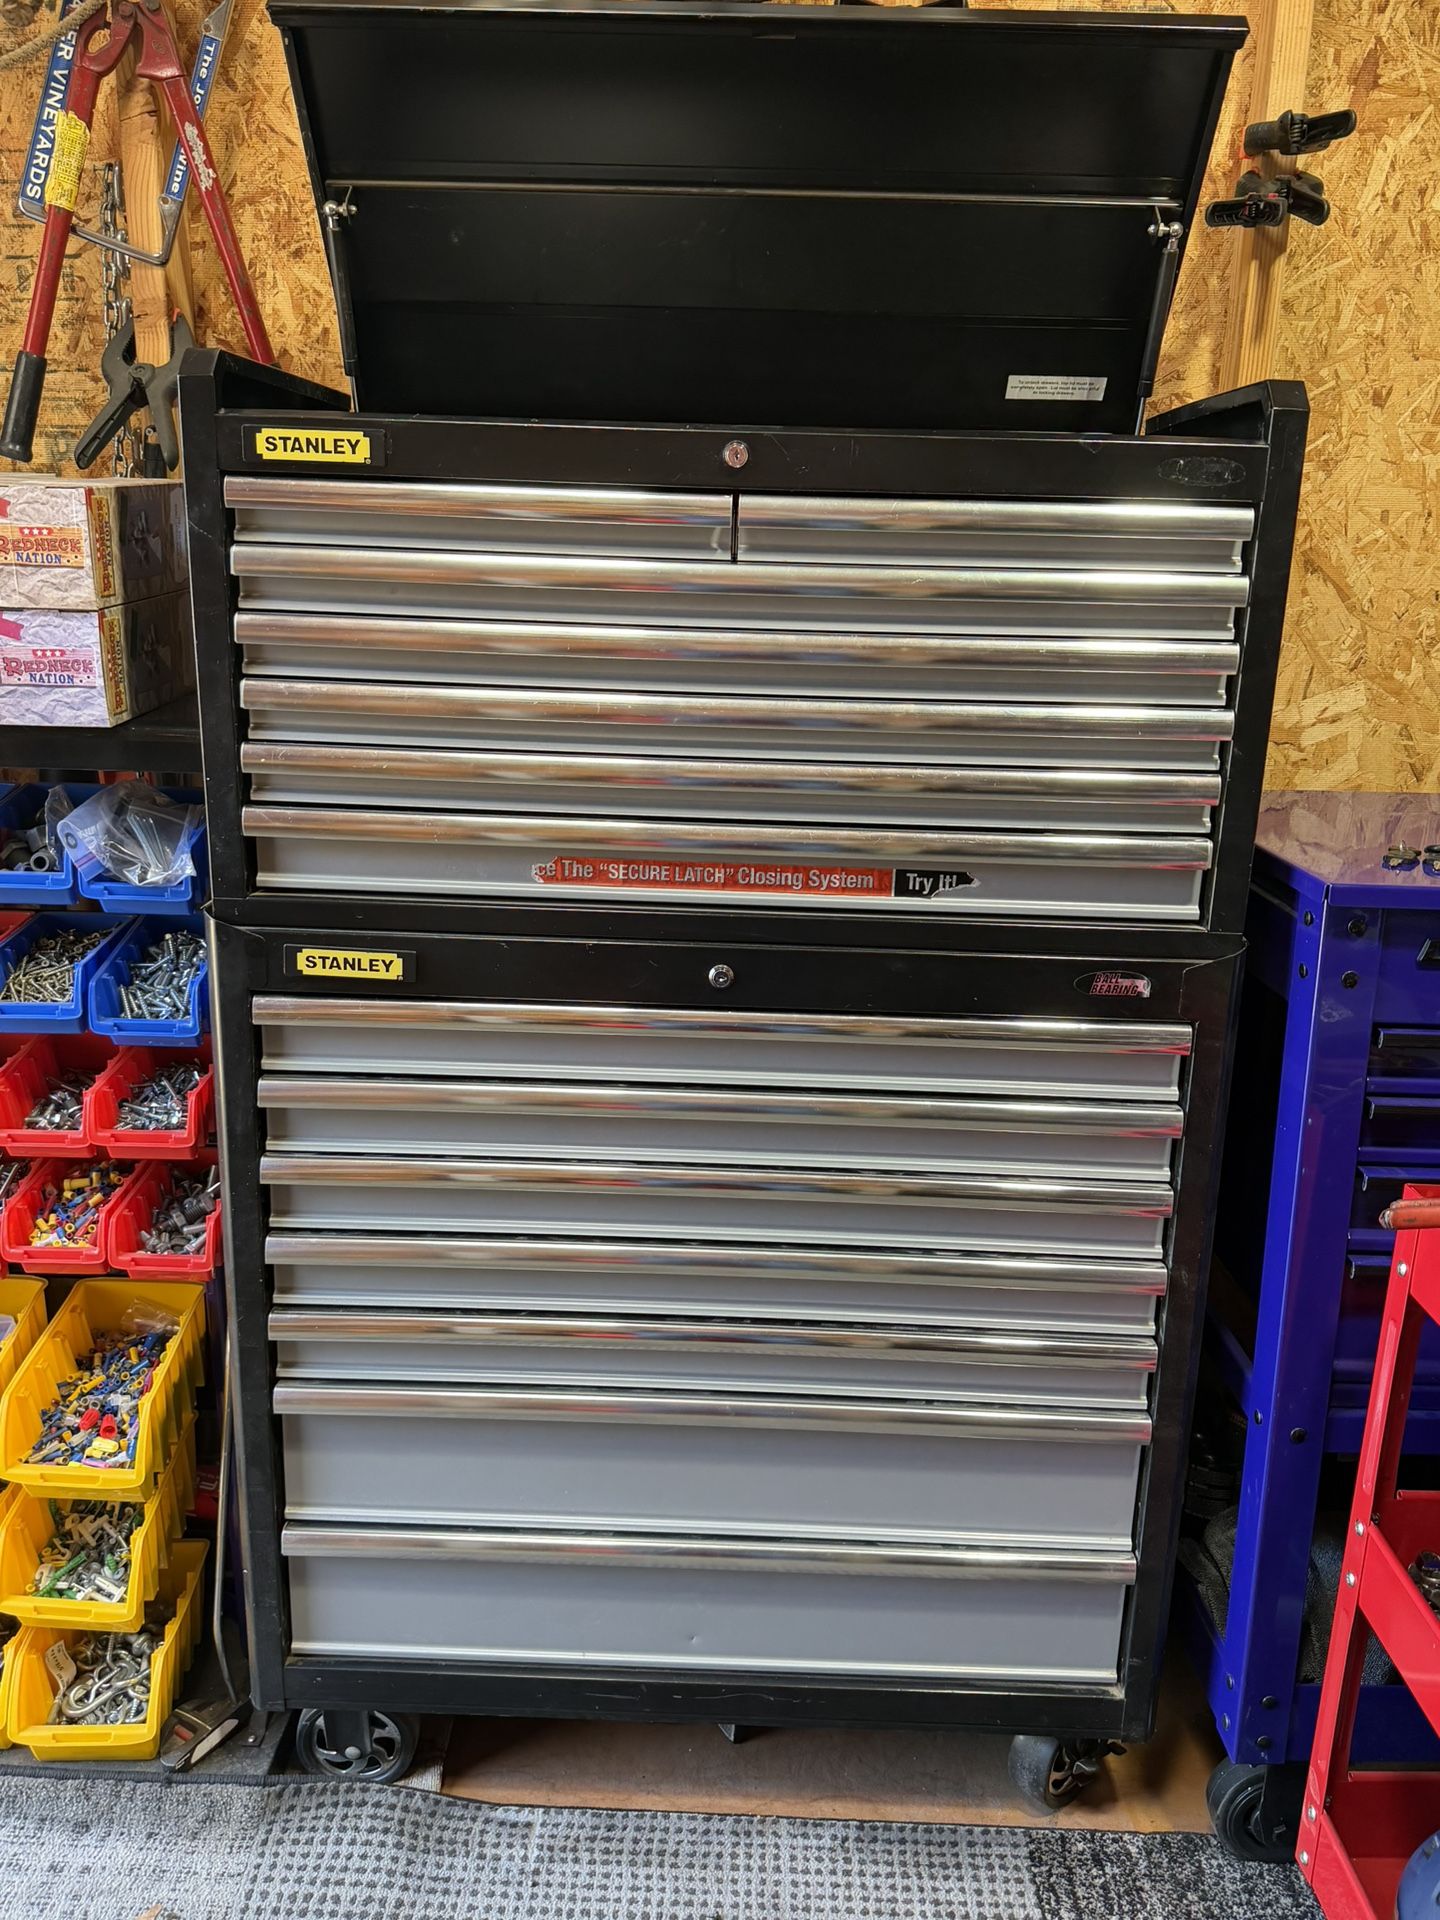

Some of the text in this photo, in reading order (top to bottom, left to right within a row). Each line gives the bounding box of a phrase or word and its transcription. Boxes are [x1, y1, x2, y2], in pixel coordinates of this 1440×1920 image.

[200, 43, 216, 79] The
[26, 69, 69, 200] VINEYARDS
[265, 436, 361, 455] STANLEY
[16, 552, 62, 564] NATION
[3, 657, 94, 676] REDNECK
[29, 673, 75, 684] NATION
[561, 860, 594, 878] The
[738, 866, 803, 889] Closing
[808, 869, 874, 889] System
[906, 873, 934, 894] Try
[305, 955, 395, 973] STANLEY
[1094, 973, 1121, 984] BALL
[1090, 984, 1139, 995] BEARING
